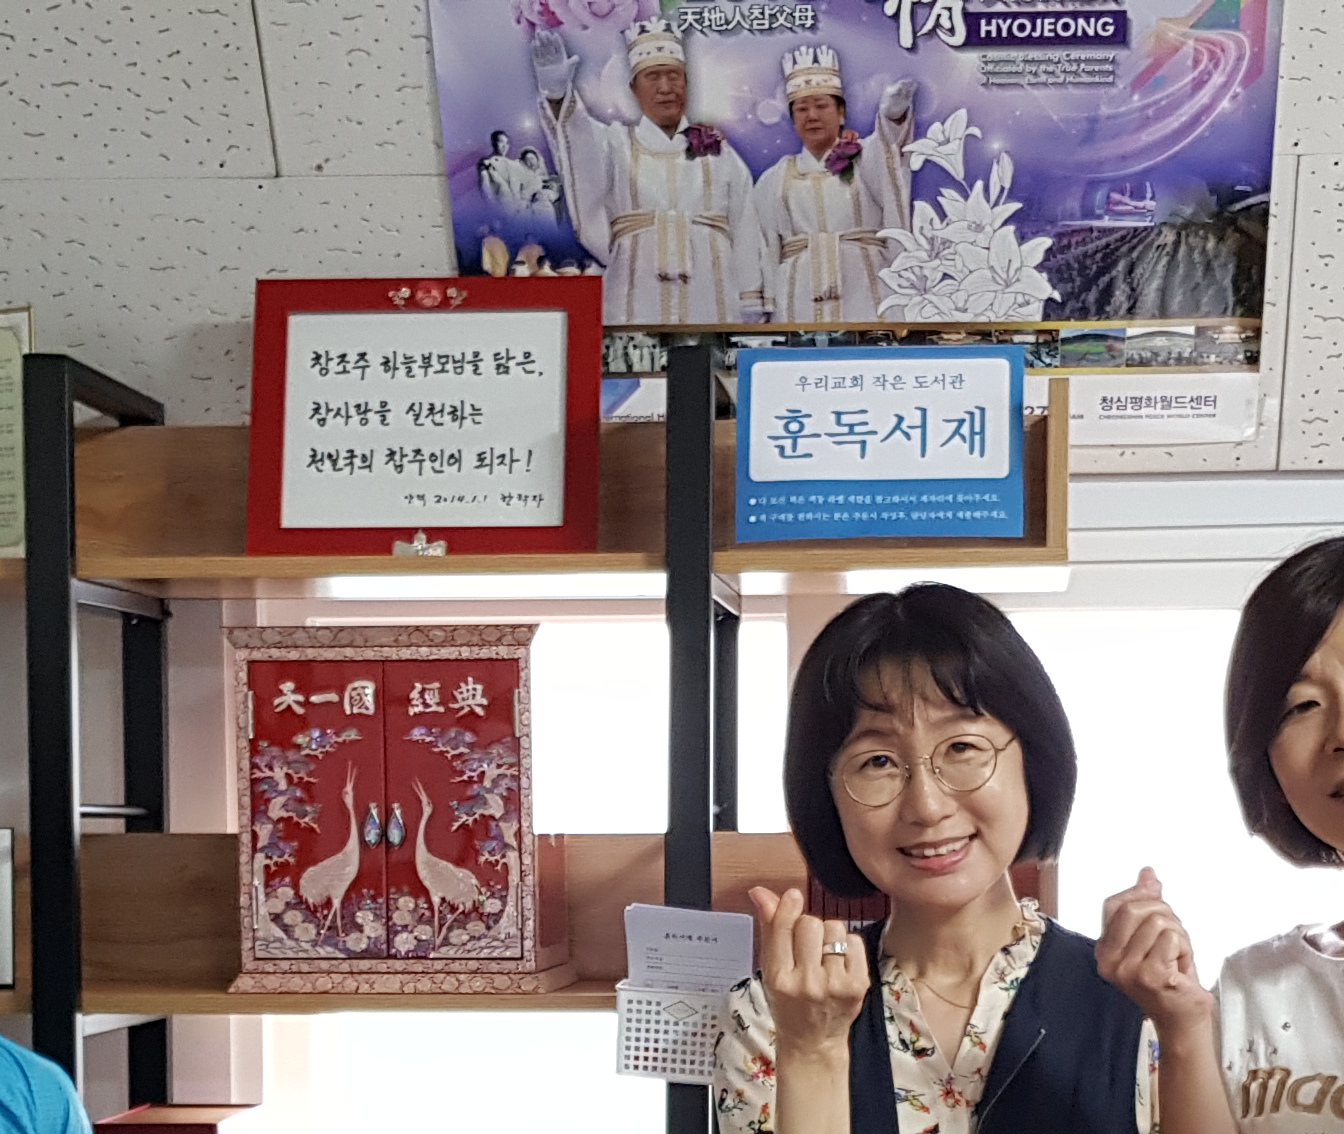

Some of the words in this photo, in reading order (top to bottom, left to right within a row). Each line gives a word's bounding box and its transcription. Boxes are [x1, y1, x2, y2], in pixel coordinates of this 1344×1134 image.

[980, 17, 1115, 37] HYOJEONG
[1062, 52, 1115, 63] Ceremony
[310, 350, 371, 380] 창조주
[379, 350, 484, 379] 하늘부모님을
[795, 375, 864, 393] 우리교회
[872, 374, 906, 391] 작은
[912, 373, 965, 390] 도서관
[308, 402, 391, 428] 참사랑을
[406, 400, 484, 430] 실천하는
[1098, 395, 1218, 411] 청심평화월드센터
[767, 405, 987, 460] 훈독서재
[305, 447, 374, 475] 천일국의
[384, 446, 463, 475] 참주인이
[273, 680, 376, 715] 天一國
[407, 676, 488, 717] 經典
